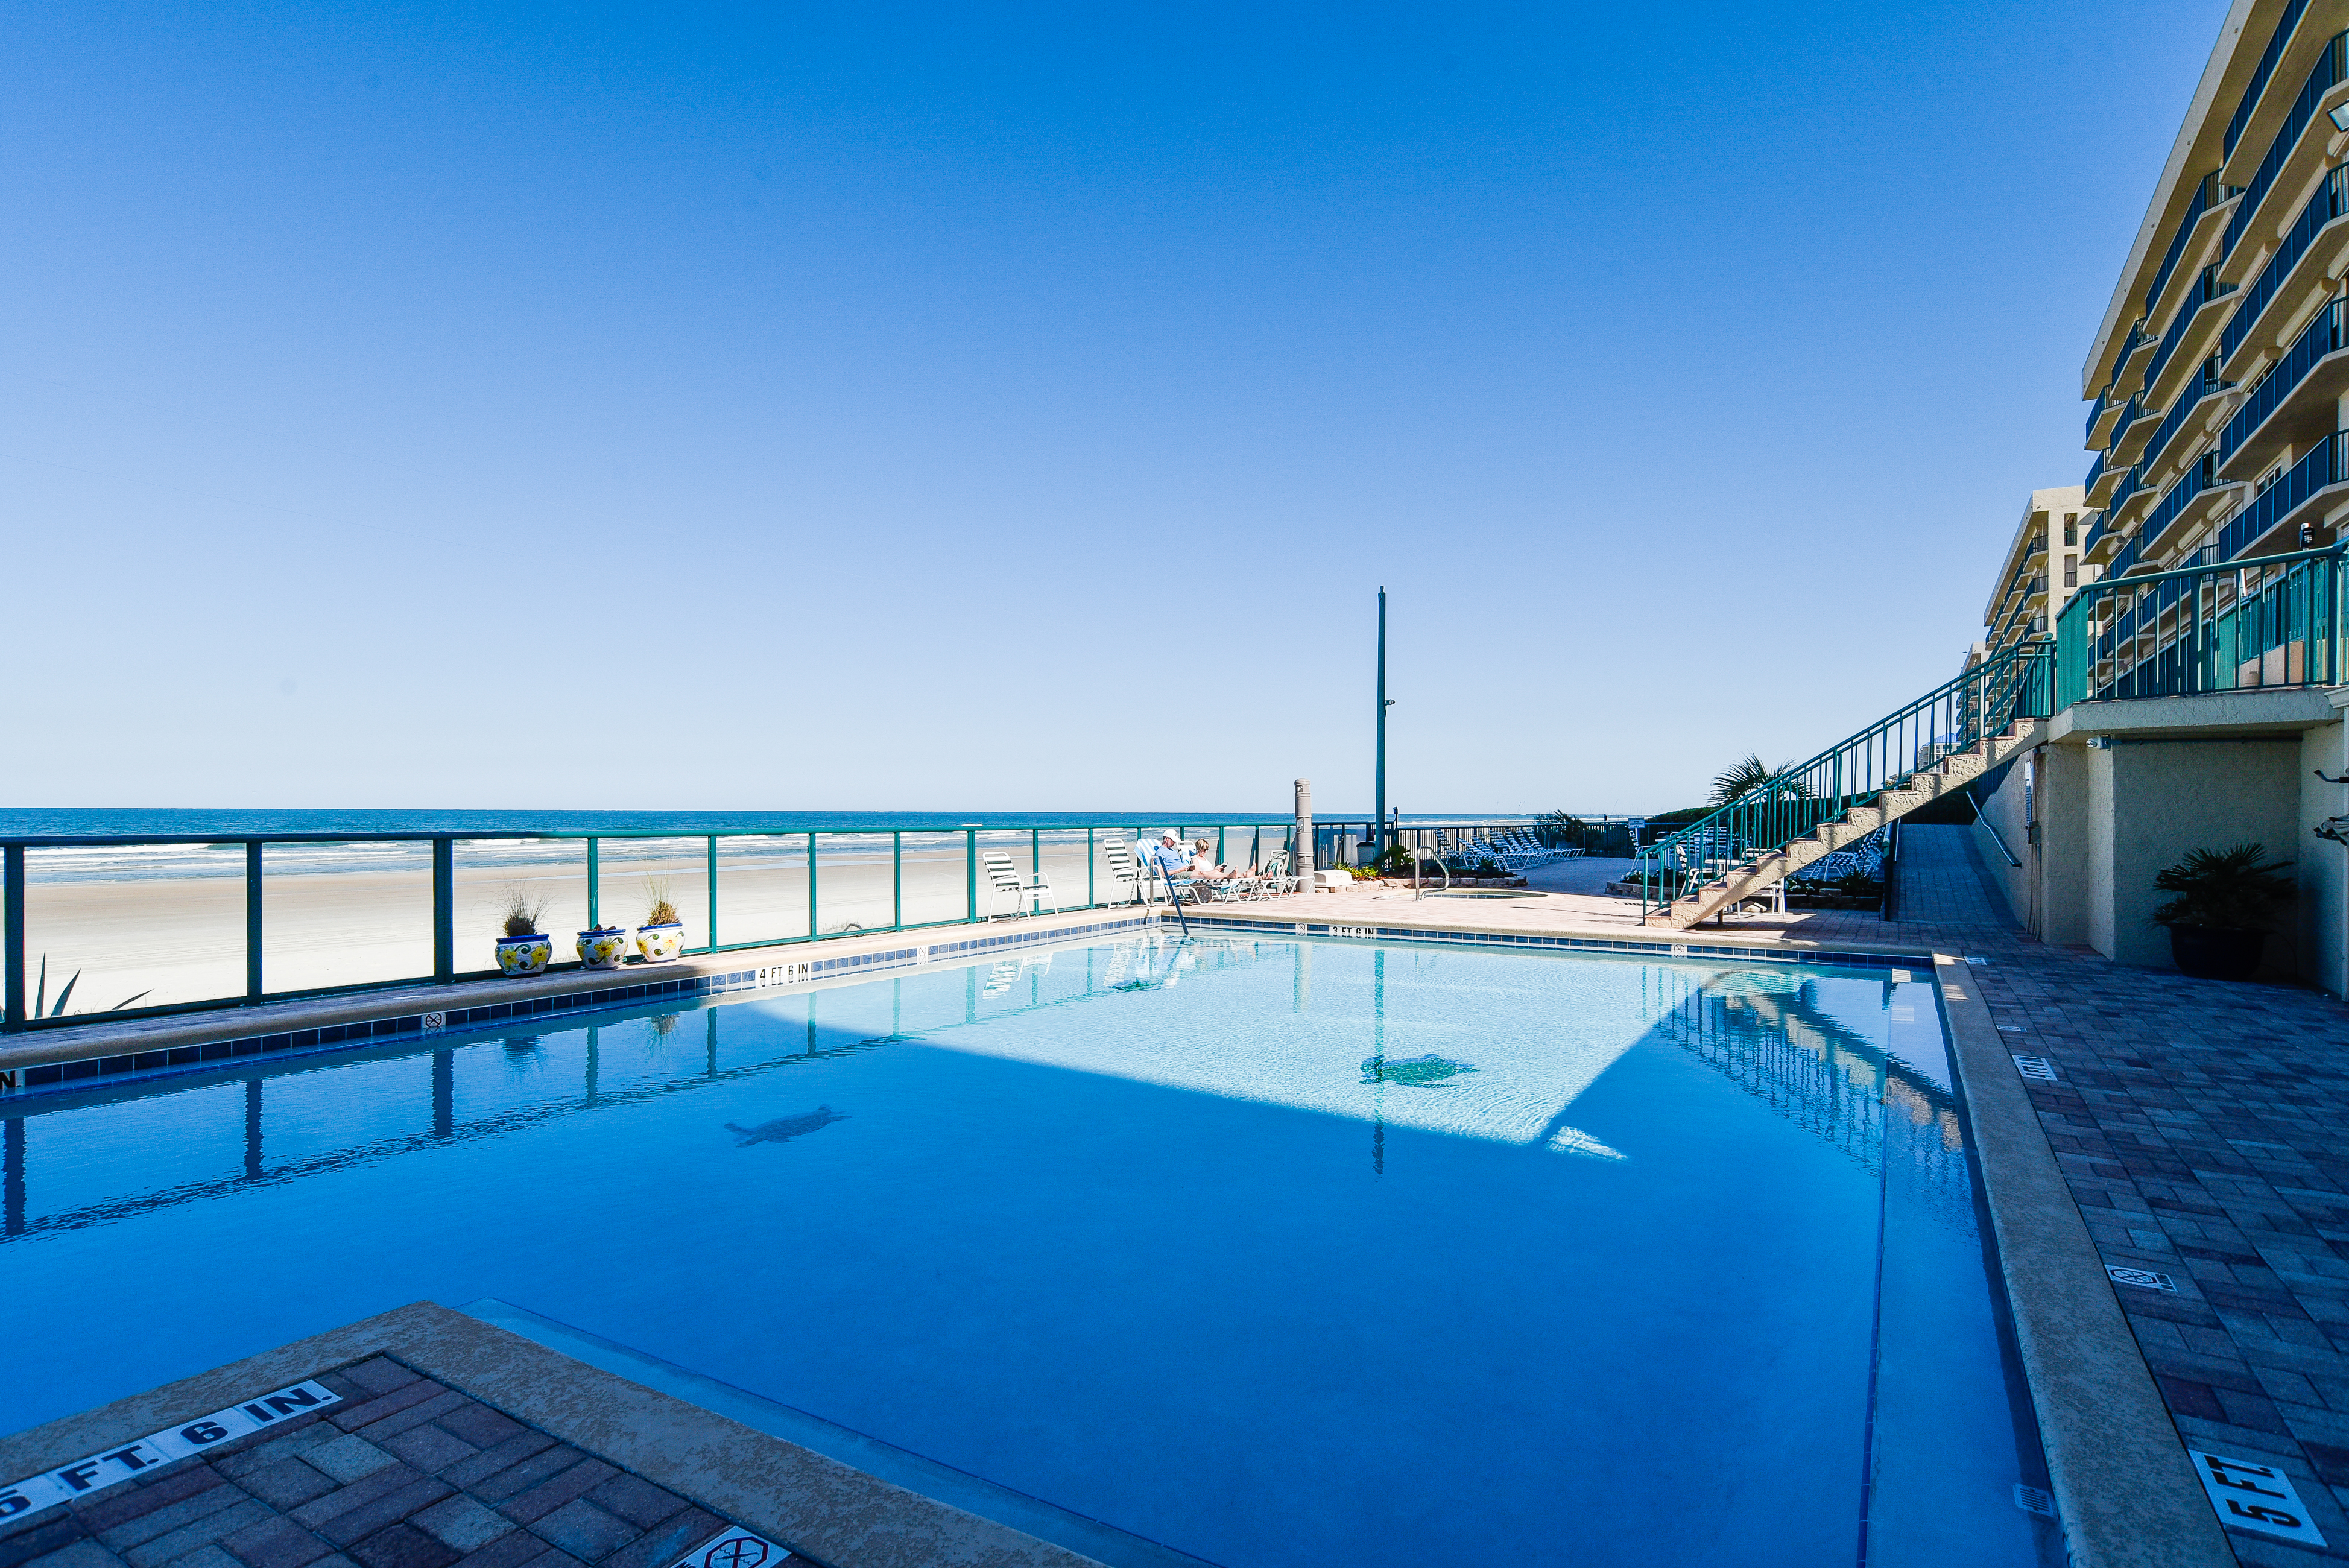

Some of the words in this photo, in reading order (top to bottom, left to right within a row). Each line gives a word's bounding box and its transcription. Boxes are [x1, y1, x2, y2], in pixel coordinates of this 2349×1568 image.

[760, 969, 765, 979] 4
[788, 965, 794, 975] 6
[798, 963, 808, 973] IN
[58, 1445, 159, 1491] FT.
[180, 1421, 229, 1444] 6
[242, 1388, 332, 1423] IN.
[2204, 1455, 2287, 1499] FT.
[2225, 1499, 2302, 1528] 5
